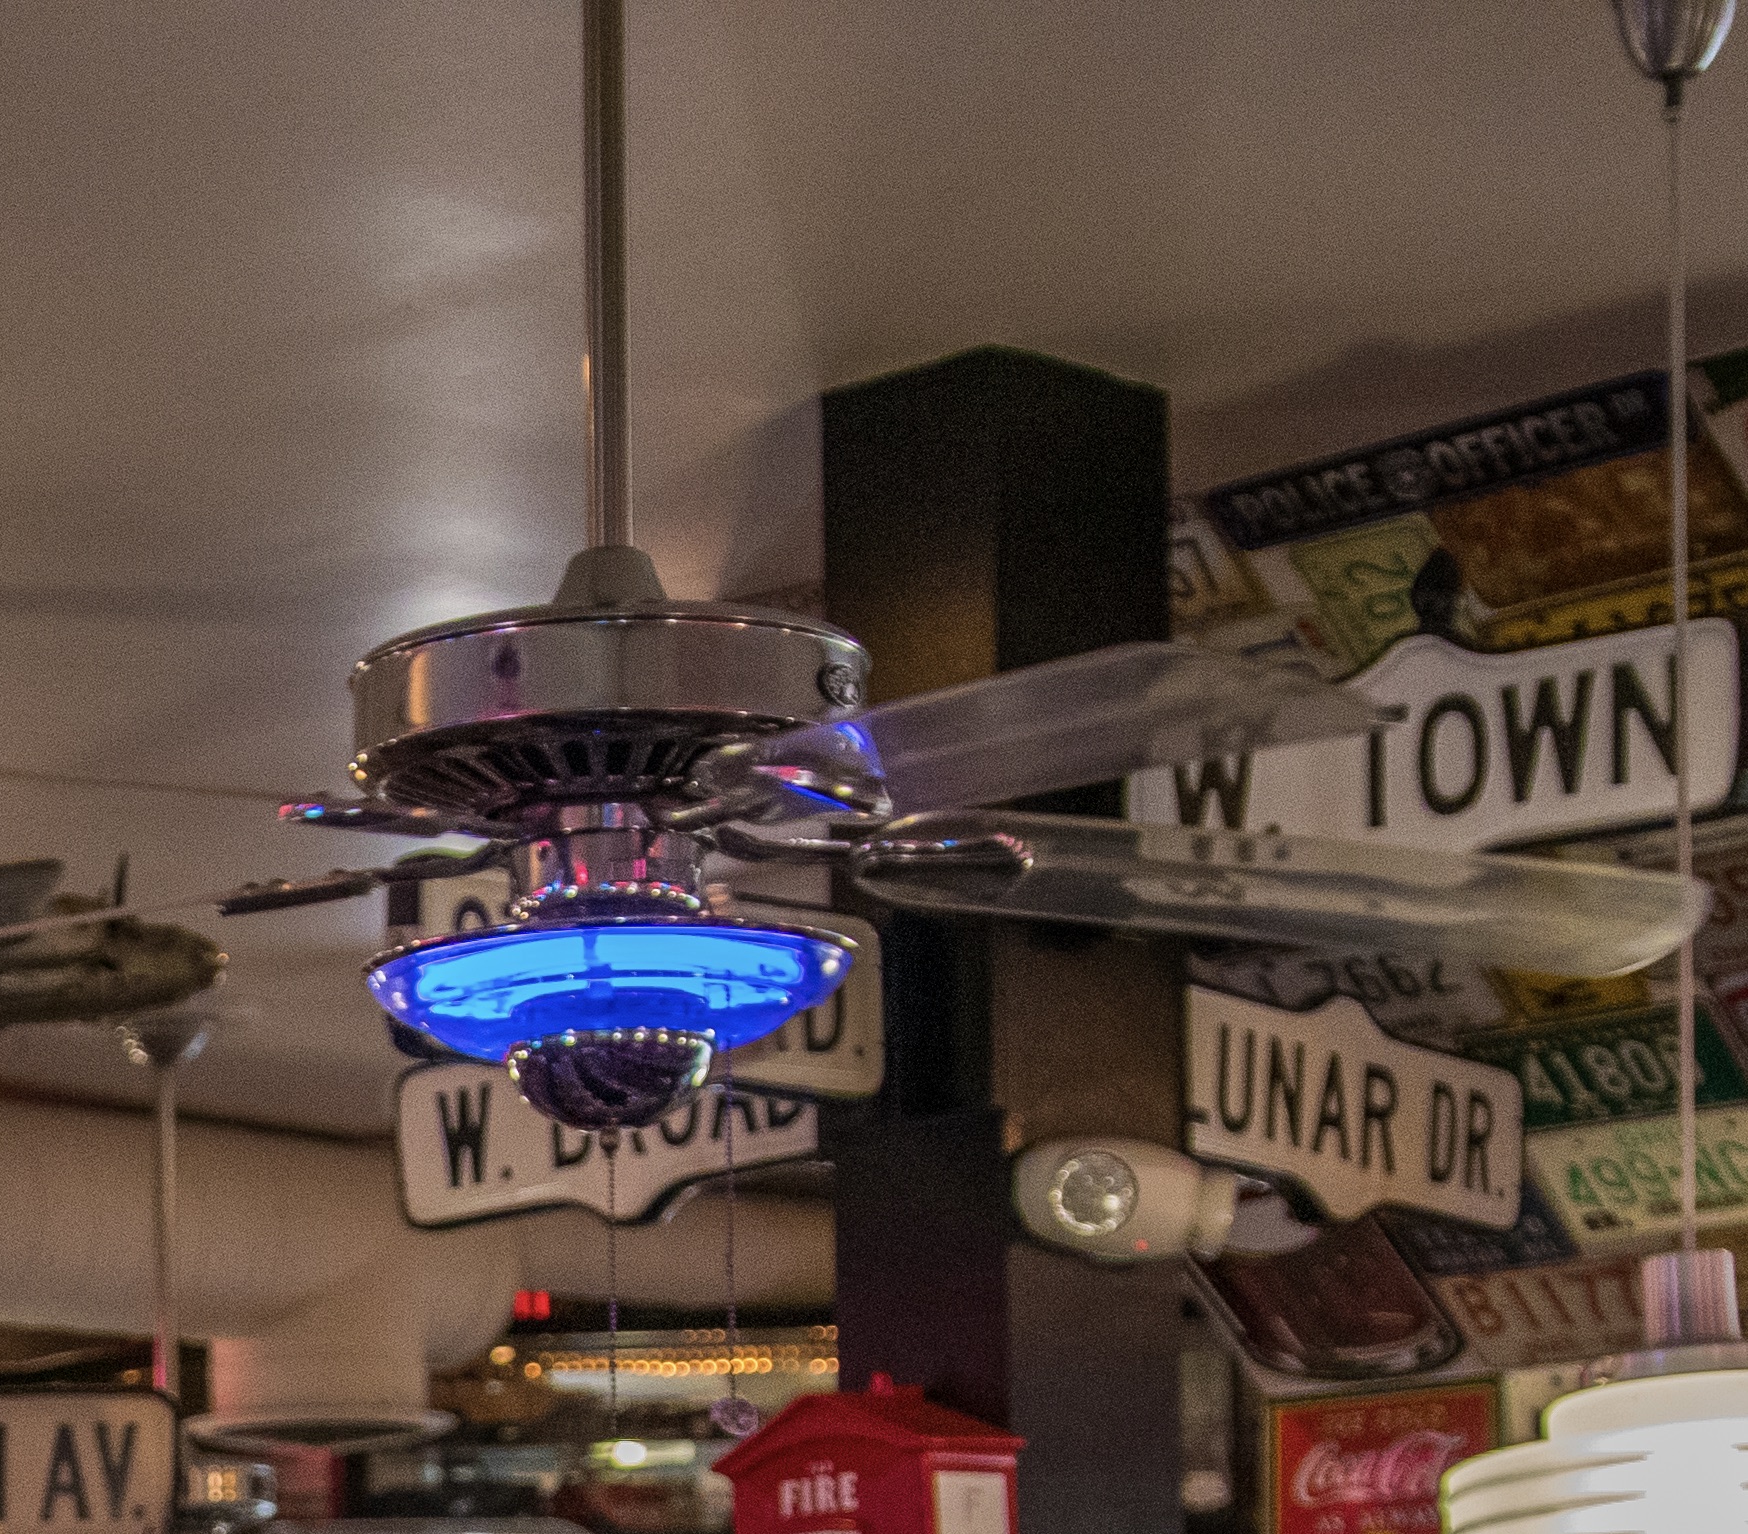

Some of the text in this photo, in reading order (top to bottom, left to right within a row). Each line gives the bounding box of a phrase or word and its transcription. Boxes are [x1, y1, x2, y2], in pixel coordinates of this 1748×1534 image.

[1426, 404, 1618, 488] OFFICER
[437, 1082, 514, 1189] W.
[1190, 1022, 1506, 1198] UNAR DR.
[39, 1420, 150, 1525] AV.
[778, 1469, 860, 1520] FIRE
